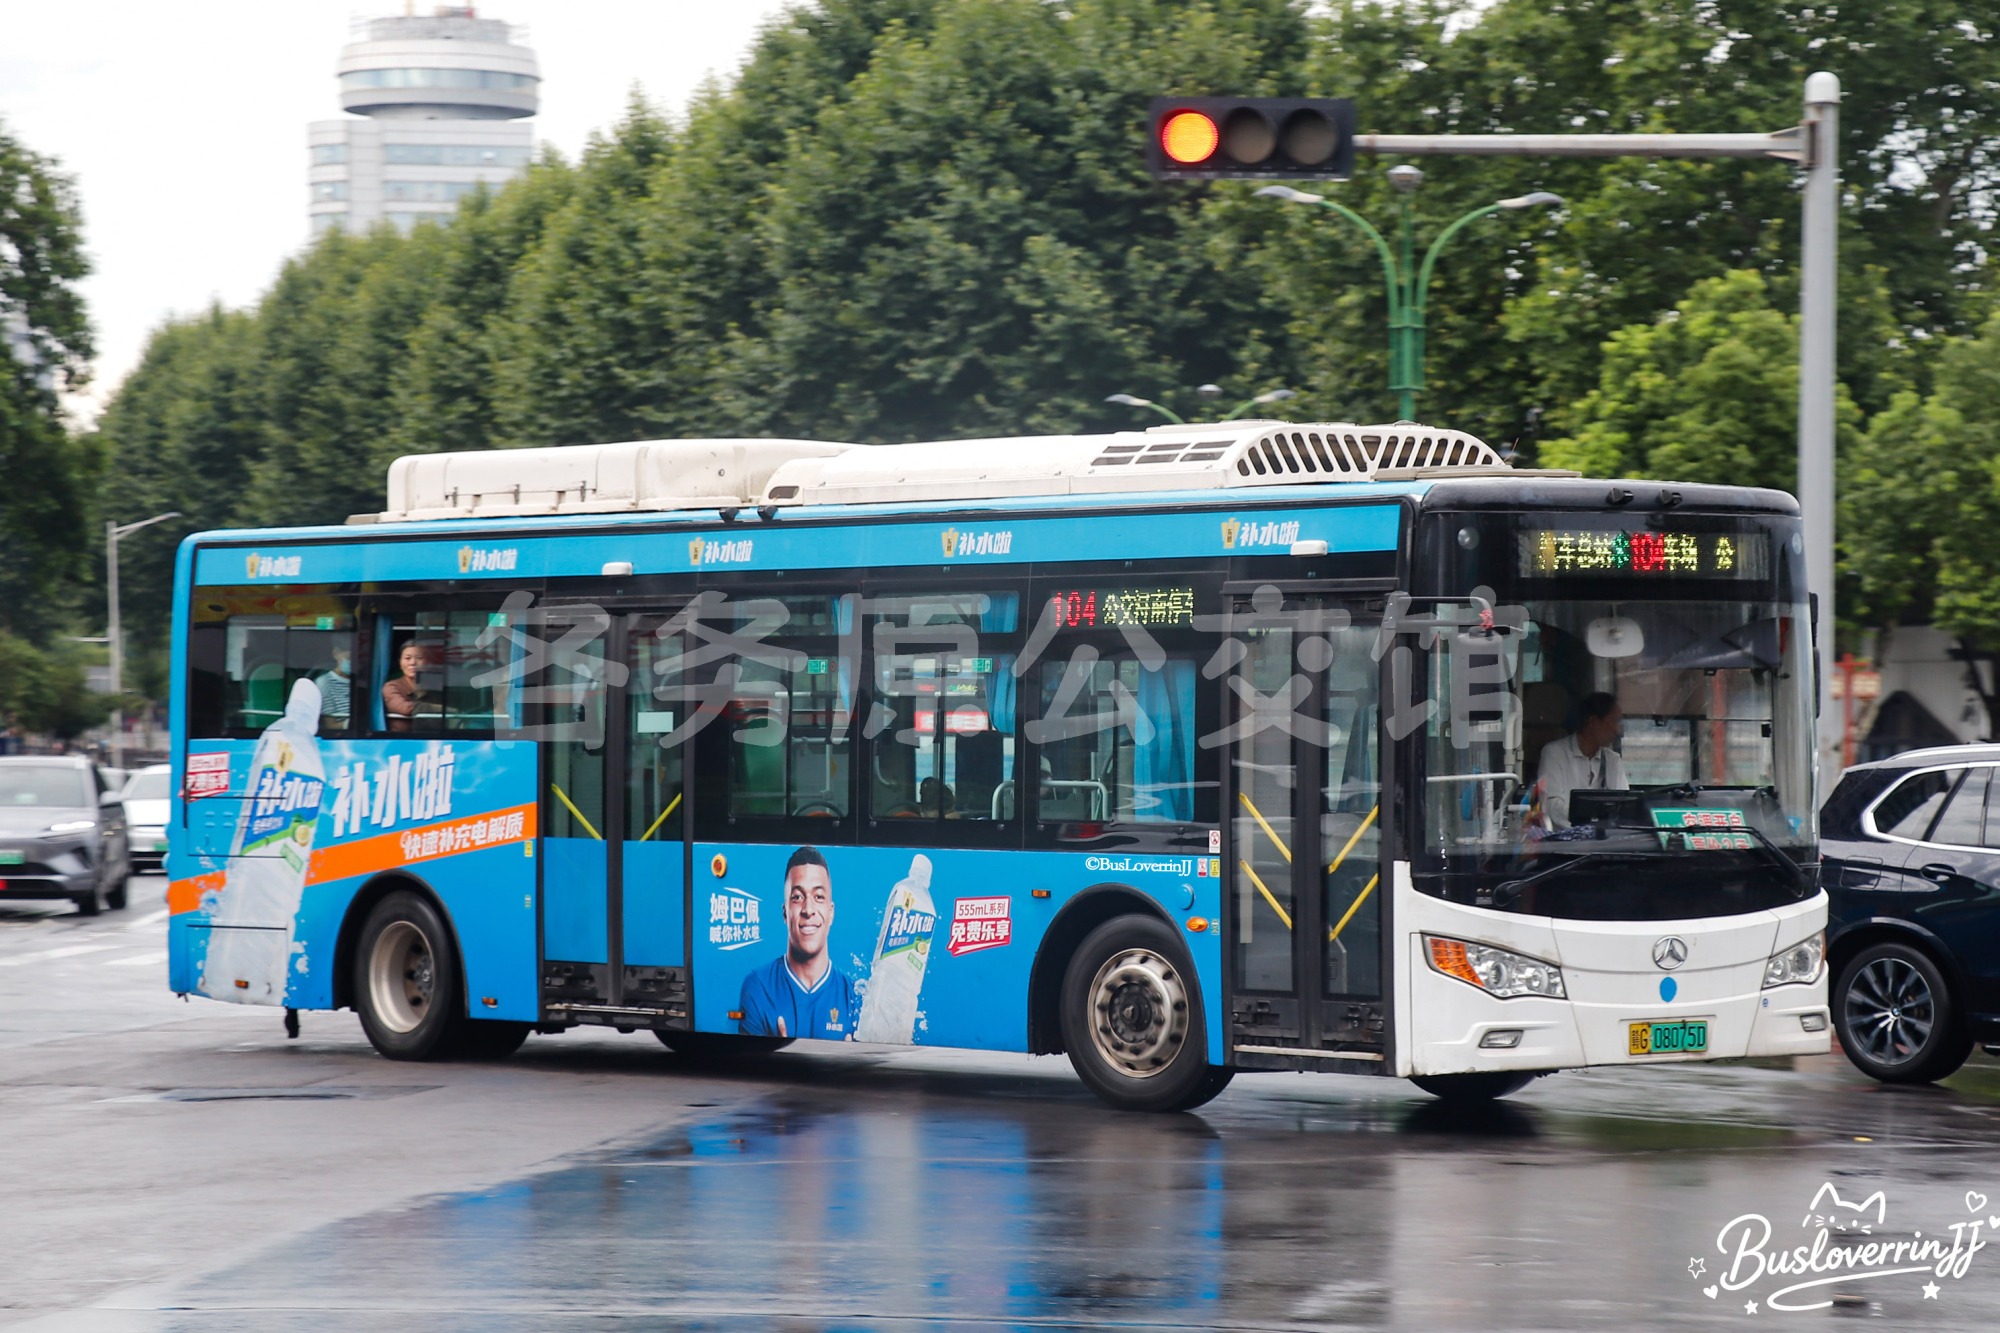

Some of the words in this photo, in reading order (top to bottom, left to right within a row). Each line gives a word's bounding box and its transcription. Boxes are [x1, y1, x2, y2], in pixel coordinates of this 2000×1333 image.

[959, 531, 1012, 555] 补水啦
[1239, 521, 1300, 547] 补水啦
[259, 556, 302, 577] 补水啦
[472, 549, 518, 571] 补水啦
[704, 540, 753, 563] 补水啦
[1631, 532, 1665, 571] 104
[1053, 591, 1096, 627] 104
[256, 770, 324, 816] 补水啦
[331, 744, 456, 838] 补水啦
[402, 811, 524, 860] 快速补充电解质
[709, 893, 761, 924] 姆巴佩
[890, 907, 934, 937] 补水啦
[958, 902, 1006, 917] 555mL系列
[709, 925, 761, 944] 喊你补水啦
[949, 919, 1010, 950] 免费乐享
